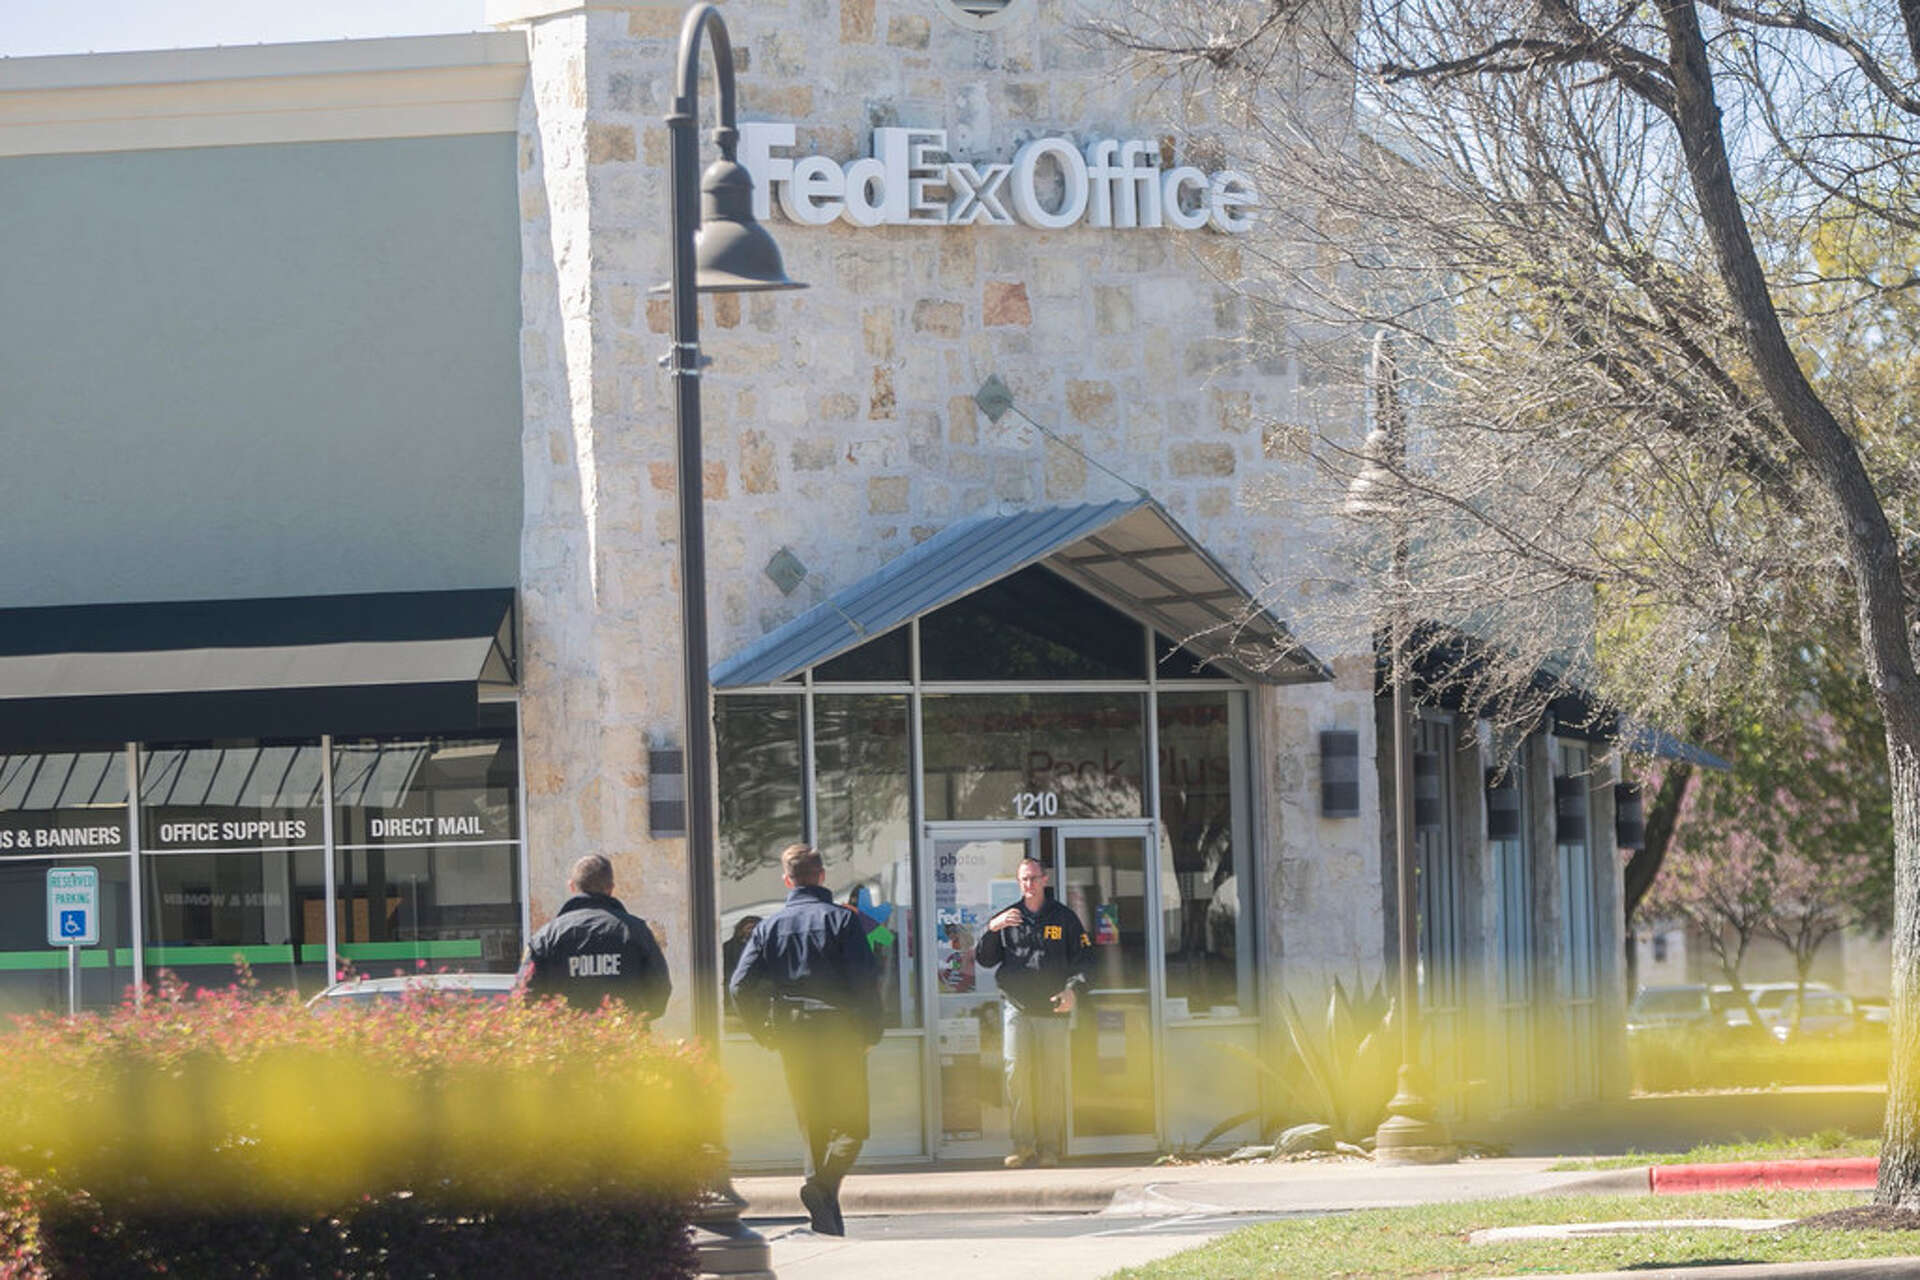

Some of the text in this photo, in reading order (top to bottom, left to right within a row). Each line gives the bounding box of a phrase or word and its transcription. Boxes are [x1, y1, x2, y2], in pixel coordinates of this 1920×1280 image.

[1012, 792, 1058, 817] 1210
[0, 826, 121, 849] S & BANNERS
[160, 820, 307, 843] OFFICE SUPPLIES
[371, 816, 485, 838] DIRECT MAIL
[51, 875, 96, 888] RESERVED
[55, 892, 90, 904] PARKING
[936, 908, 977, 925] FedEx
[1043, 925, 1062, 940] FBI
[569, 953, 621, 977] POLICE
